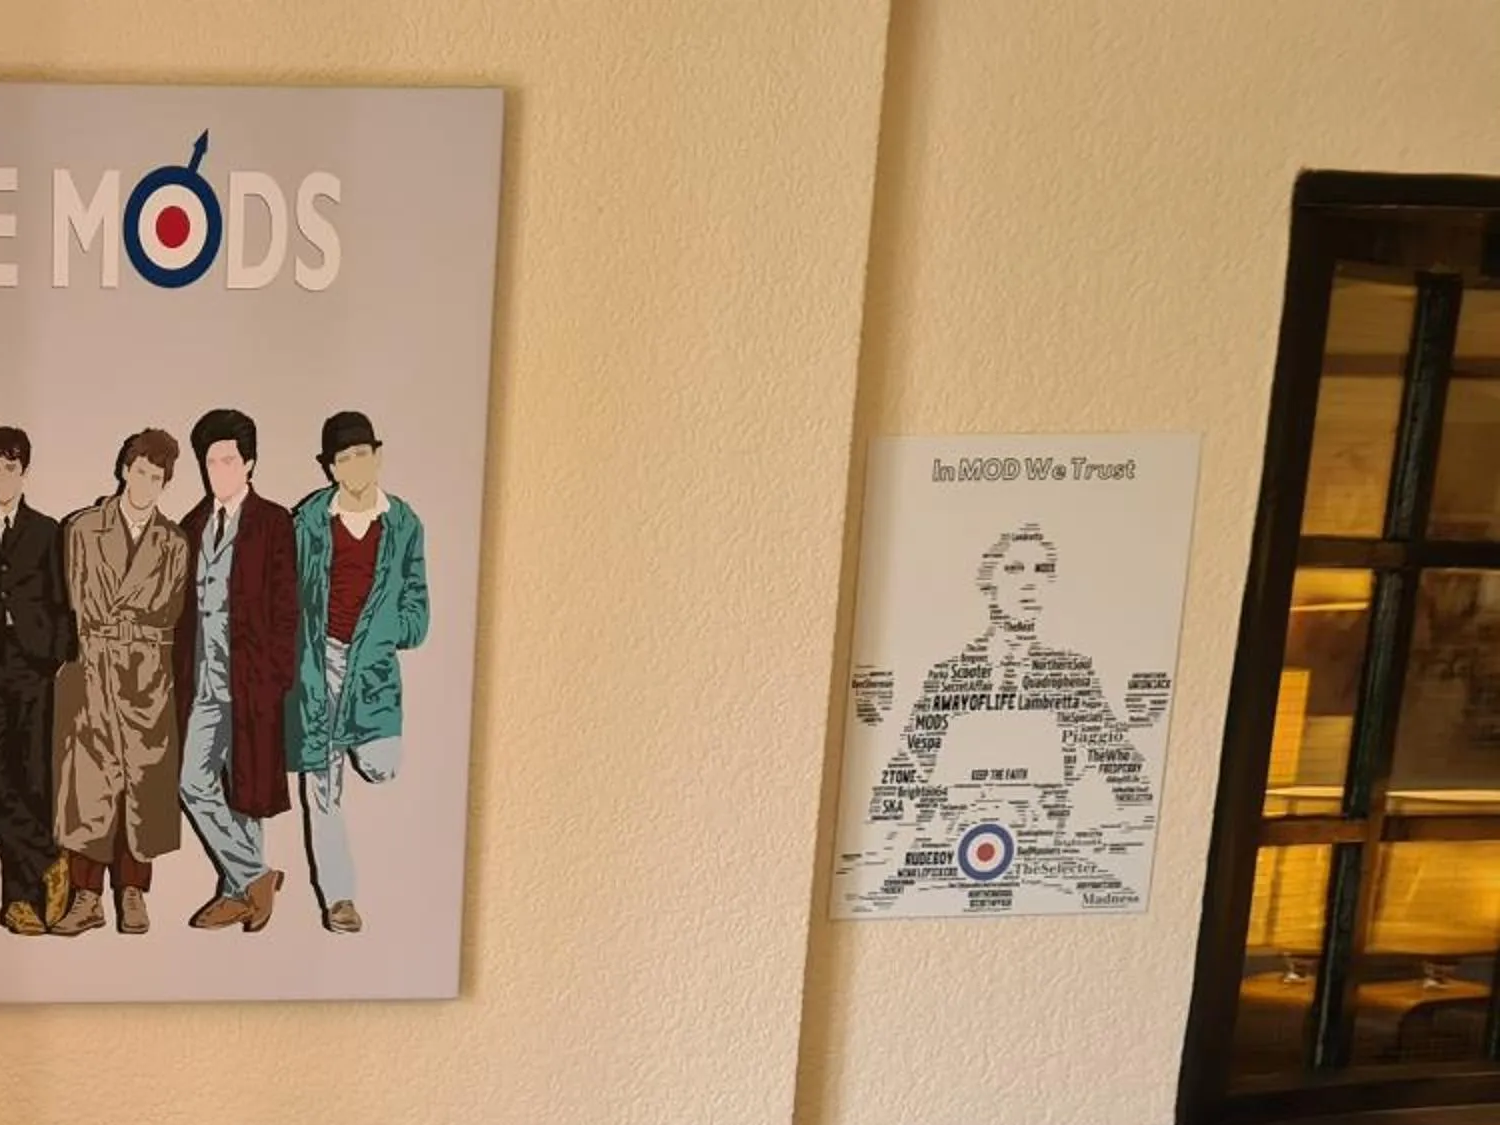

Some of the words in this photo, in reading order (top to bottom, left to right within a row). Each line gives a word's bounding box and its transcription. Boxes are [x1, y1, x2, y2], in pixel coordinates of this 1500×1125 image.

[52, 164, 342, 292] MODS
[932, 458, 956, 482] In
[958, 457, 1022, 482] MOD
[1025, 457, 1067, 481] We
[1071, 456, 1137, 481] Trust
[951, 664, 992, 679] Scooter
[932, 693, 1016, 711] AWAYOFLIFE
[1018, 694, 1080, 711] Lambretta
[915, 714, 949, 731] MODS
[907, 733, 943, 752] Vespa
[1062, 729, 1124, 746] Piaggio
[1088, 749, 1131, 762] TheWho
[881, 769, 917, 784] 2TONE
[883, 799, 904, 814] SKA
[905, 851, 955, 866] RUDEBOY
[1014, 863, 1098, 875] TheSelecter
[1083, 893, 1140, 905] Madness
